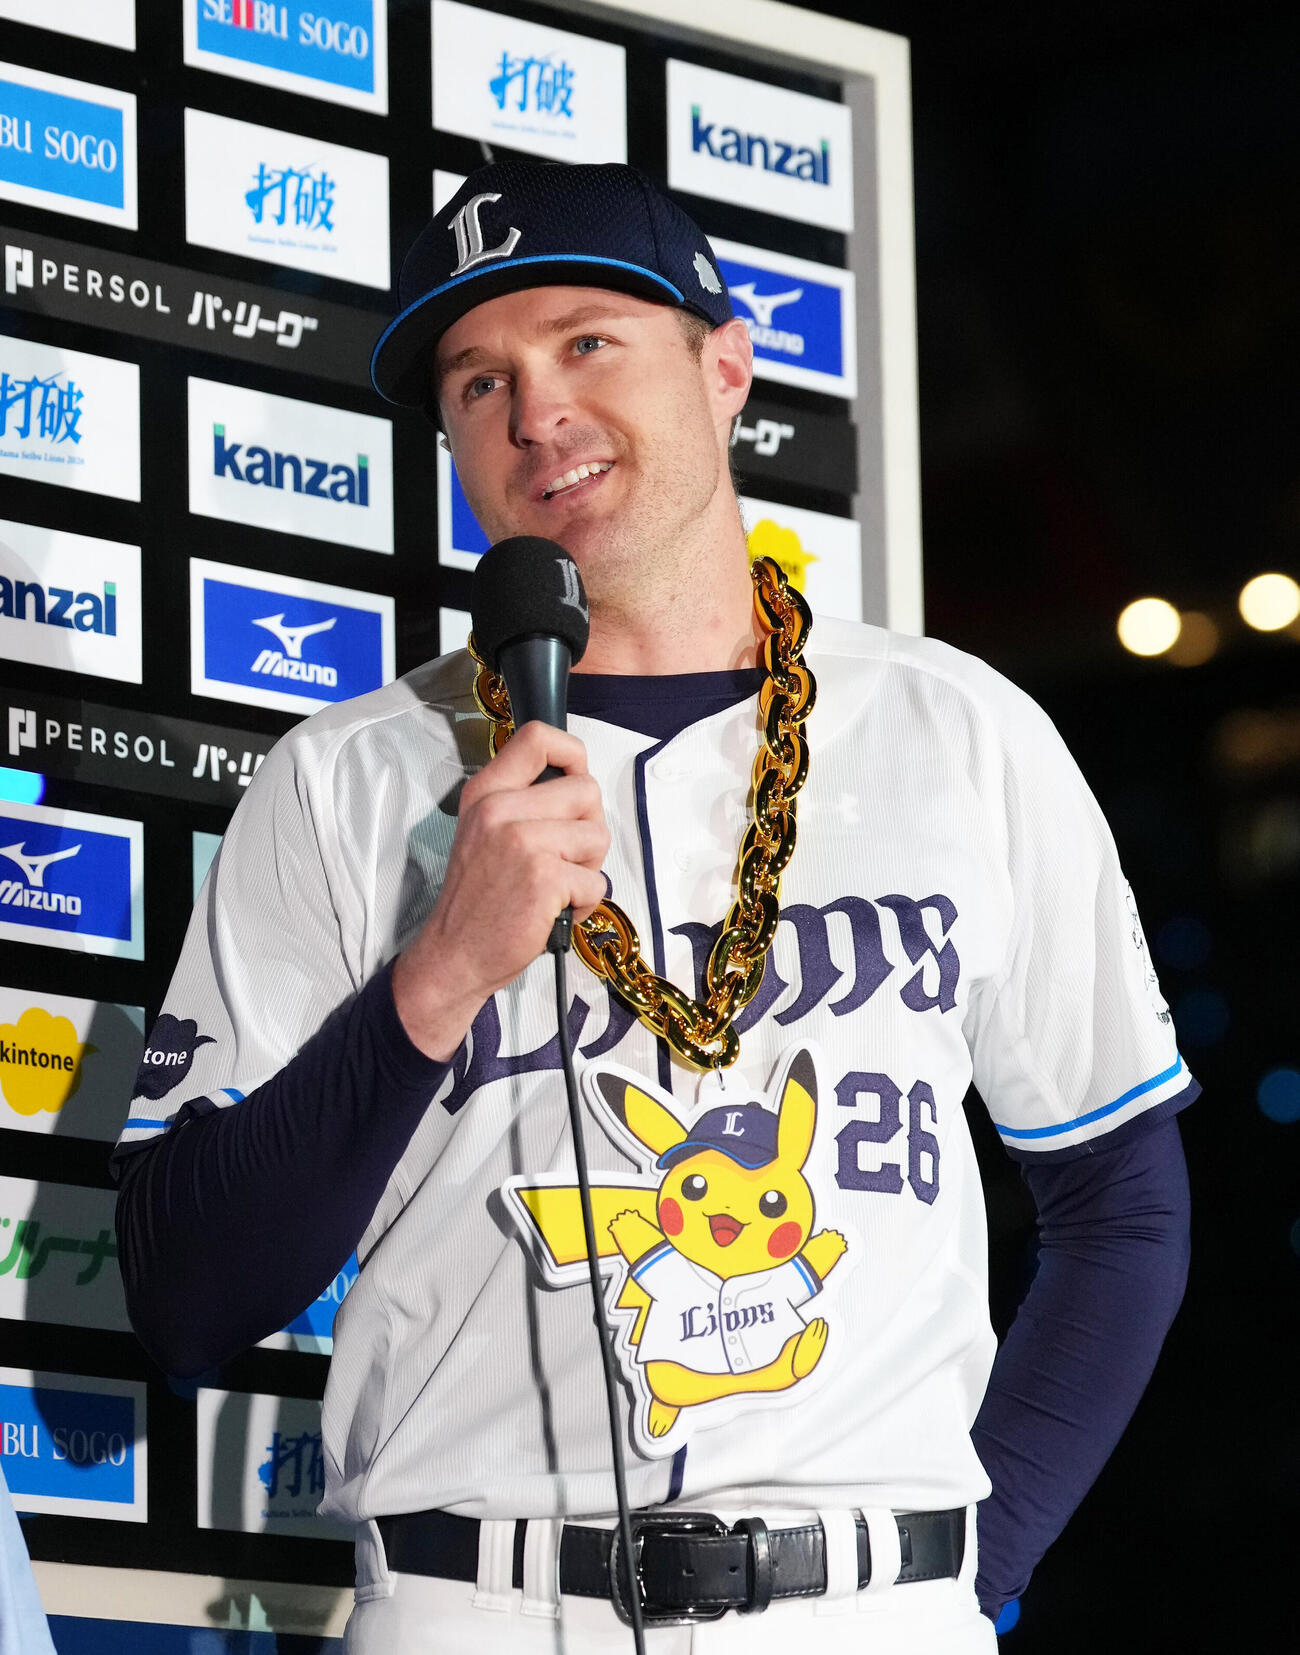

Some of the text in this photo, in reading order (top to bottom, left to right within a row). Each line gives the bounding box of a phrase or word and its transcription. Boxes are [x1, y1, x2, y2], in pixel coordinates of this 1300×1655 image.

[203, 0, 369, 60] SEIBU SOGO
[489, 50, 574, 118] 打破
[0, 114, 117, 173] BU SOGO
[691, 104, 829, 186] kanzai
[245, 161, 336, 232] 打破
[448, 193, 522, 278] L
[42, 258, 171, 314] PERSOL
[0, 372, 84, 445] 打破
[213, 422, 370, 507] kanzai
[250, 649, 338, 687] MIZUNO
[45, 719, 176, 767] PERSOL
[0, 879, 82, 916] MIZUNO
[0, 1040, 74, 1072] kintone
[143, 1047, 187, 1066] tone
[722, 1111, 746, 1137] L
[834, 1071, 941, 1206] 26
[0, 1217, 119, 1286] ルーナ
[679, 1302, 775, 1342] Lions
[3, 1422, 127, 1467] BU SOGO
